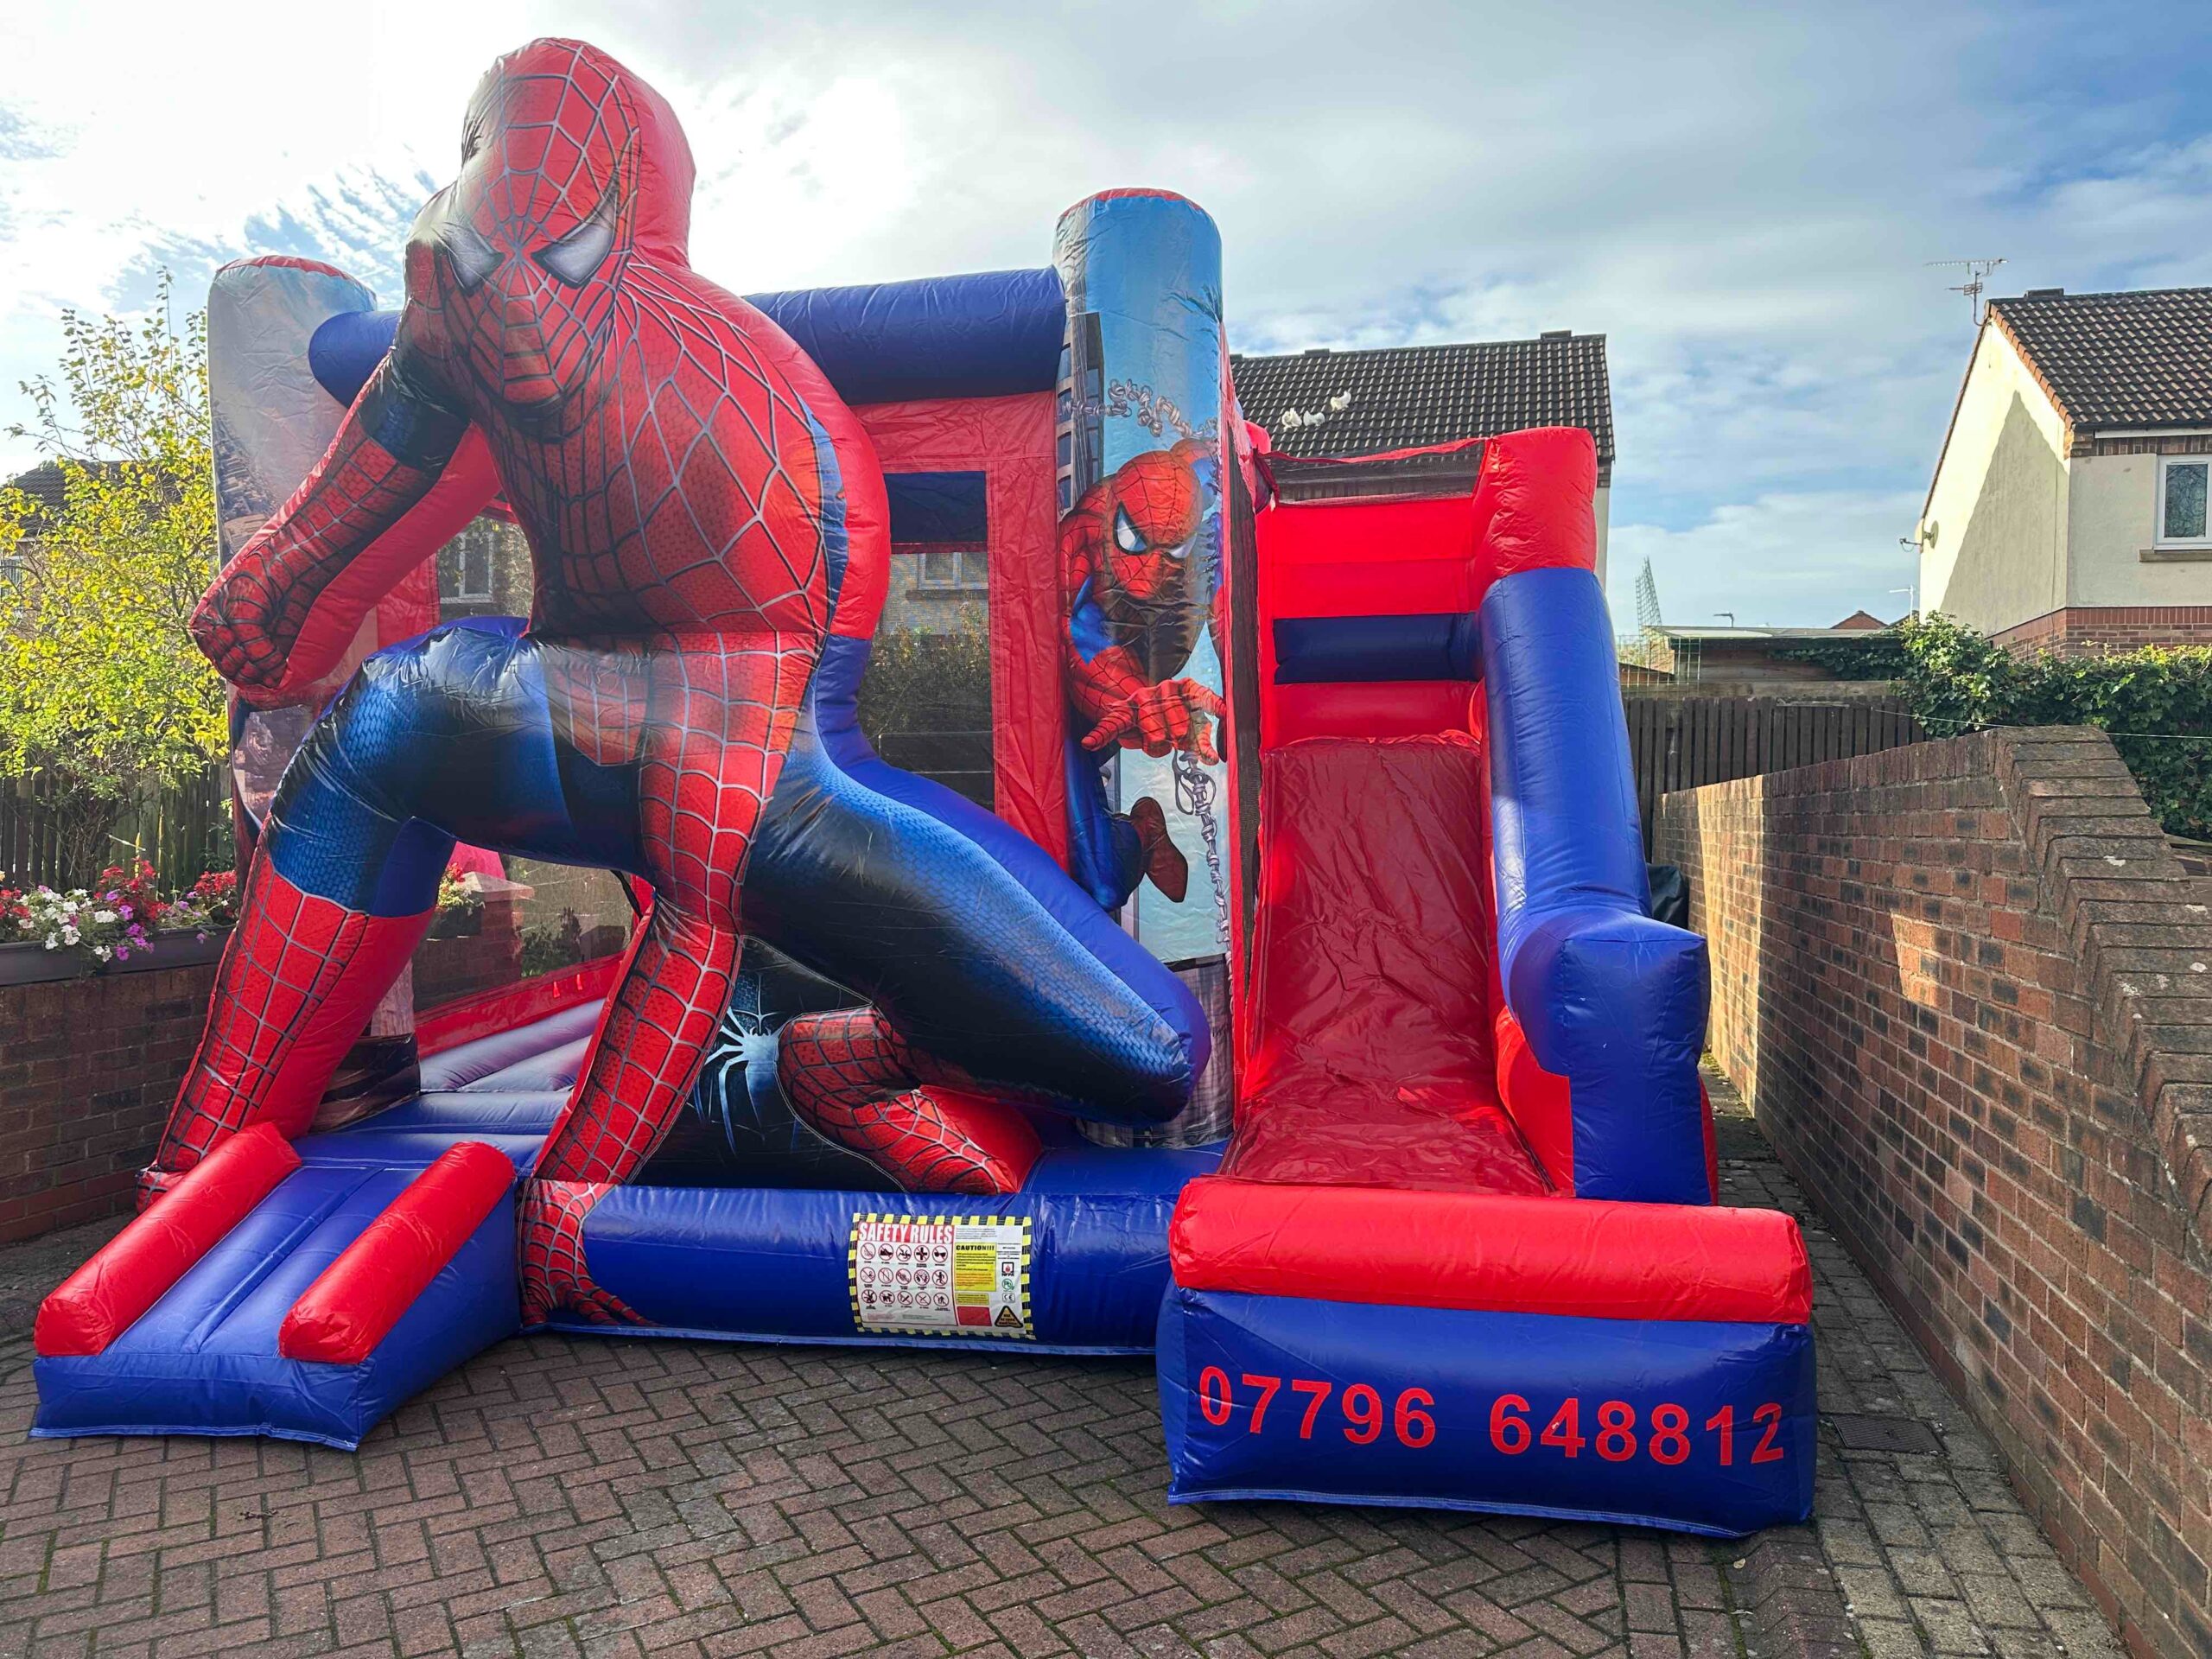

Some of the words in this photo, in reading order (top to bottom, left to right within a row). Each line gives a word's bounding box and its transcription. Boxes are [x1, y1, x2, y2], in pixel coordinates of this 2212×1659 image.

[859, 1222, 909, 1243] SAFETY
[910, 1224, 953, 1244] RULES
[1199, 1366, 1436, 1448] 07796
[1490, 1394, 1783, 1465] 648812
